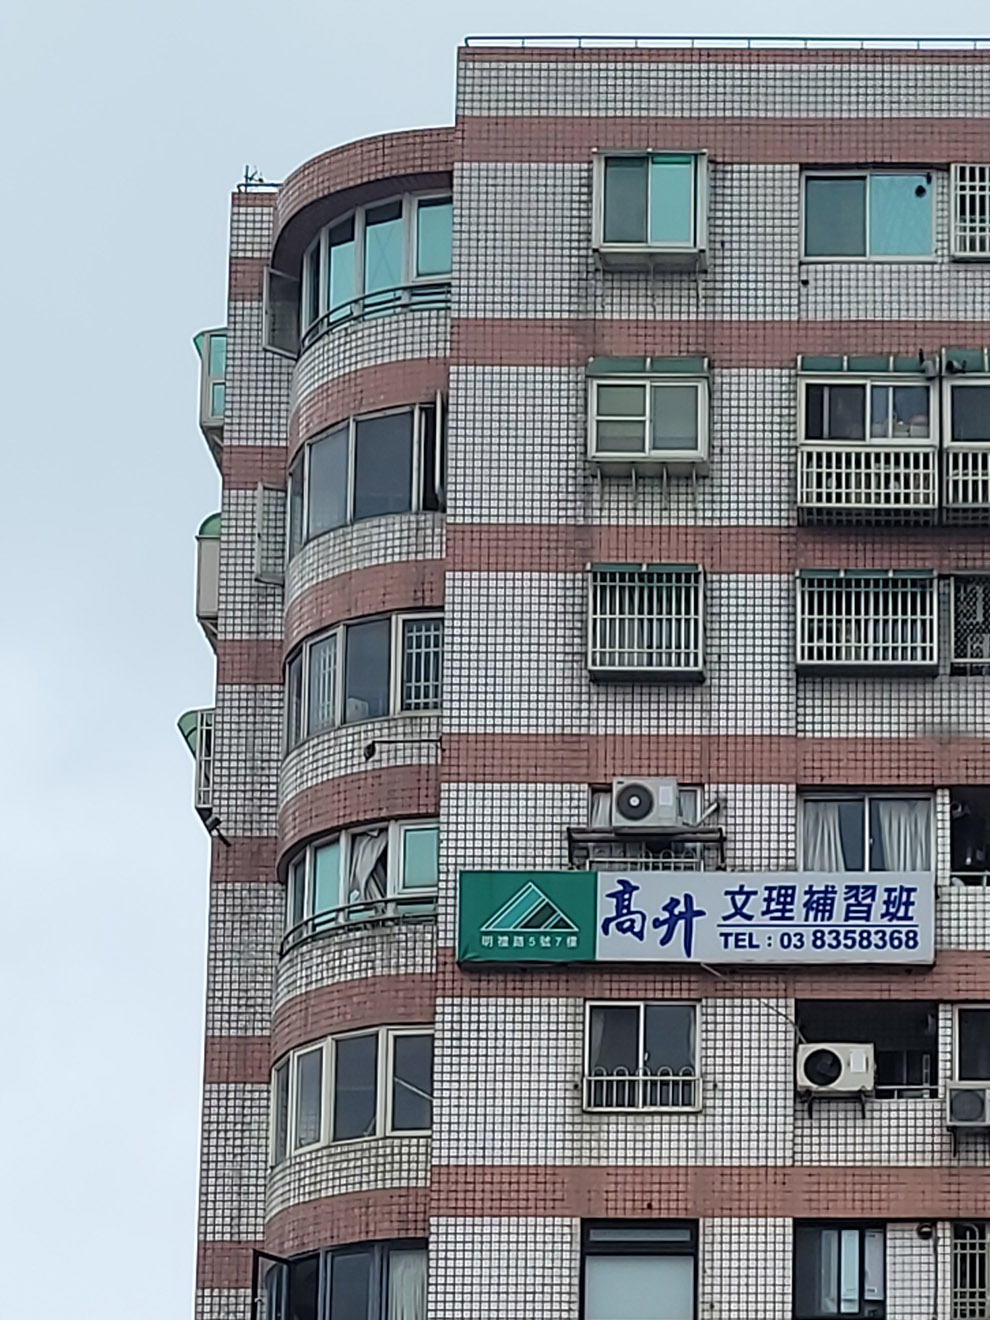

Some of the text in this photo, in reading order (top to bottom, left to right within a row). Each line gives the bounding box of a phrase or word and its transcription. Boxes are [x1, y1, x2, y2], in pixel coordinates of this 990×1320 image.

[601, 879, 918, 959] 高升 文理補習班
[779, 932, 805, 949] 03
[812, 929, 919, 949] 8358368
